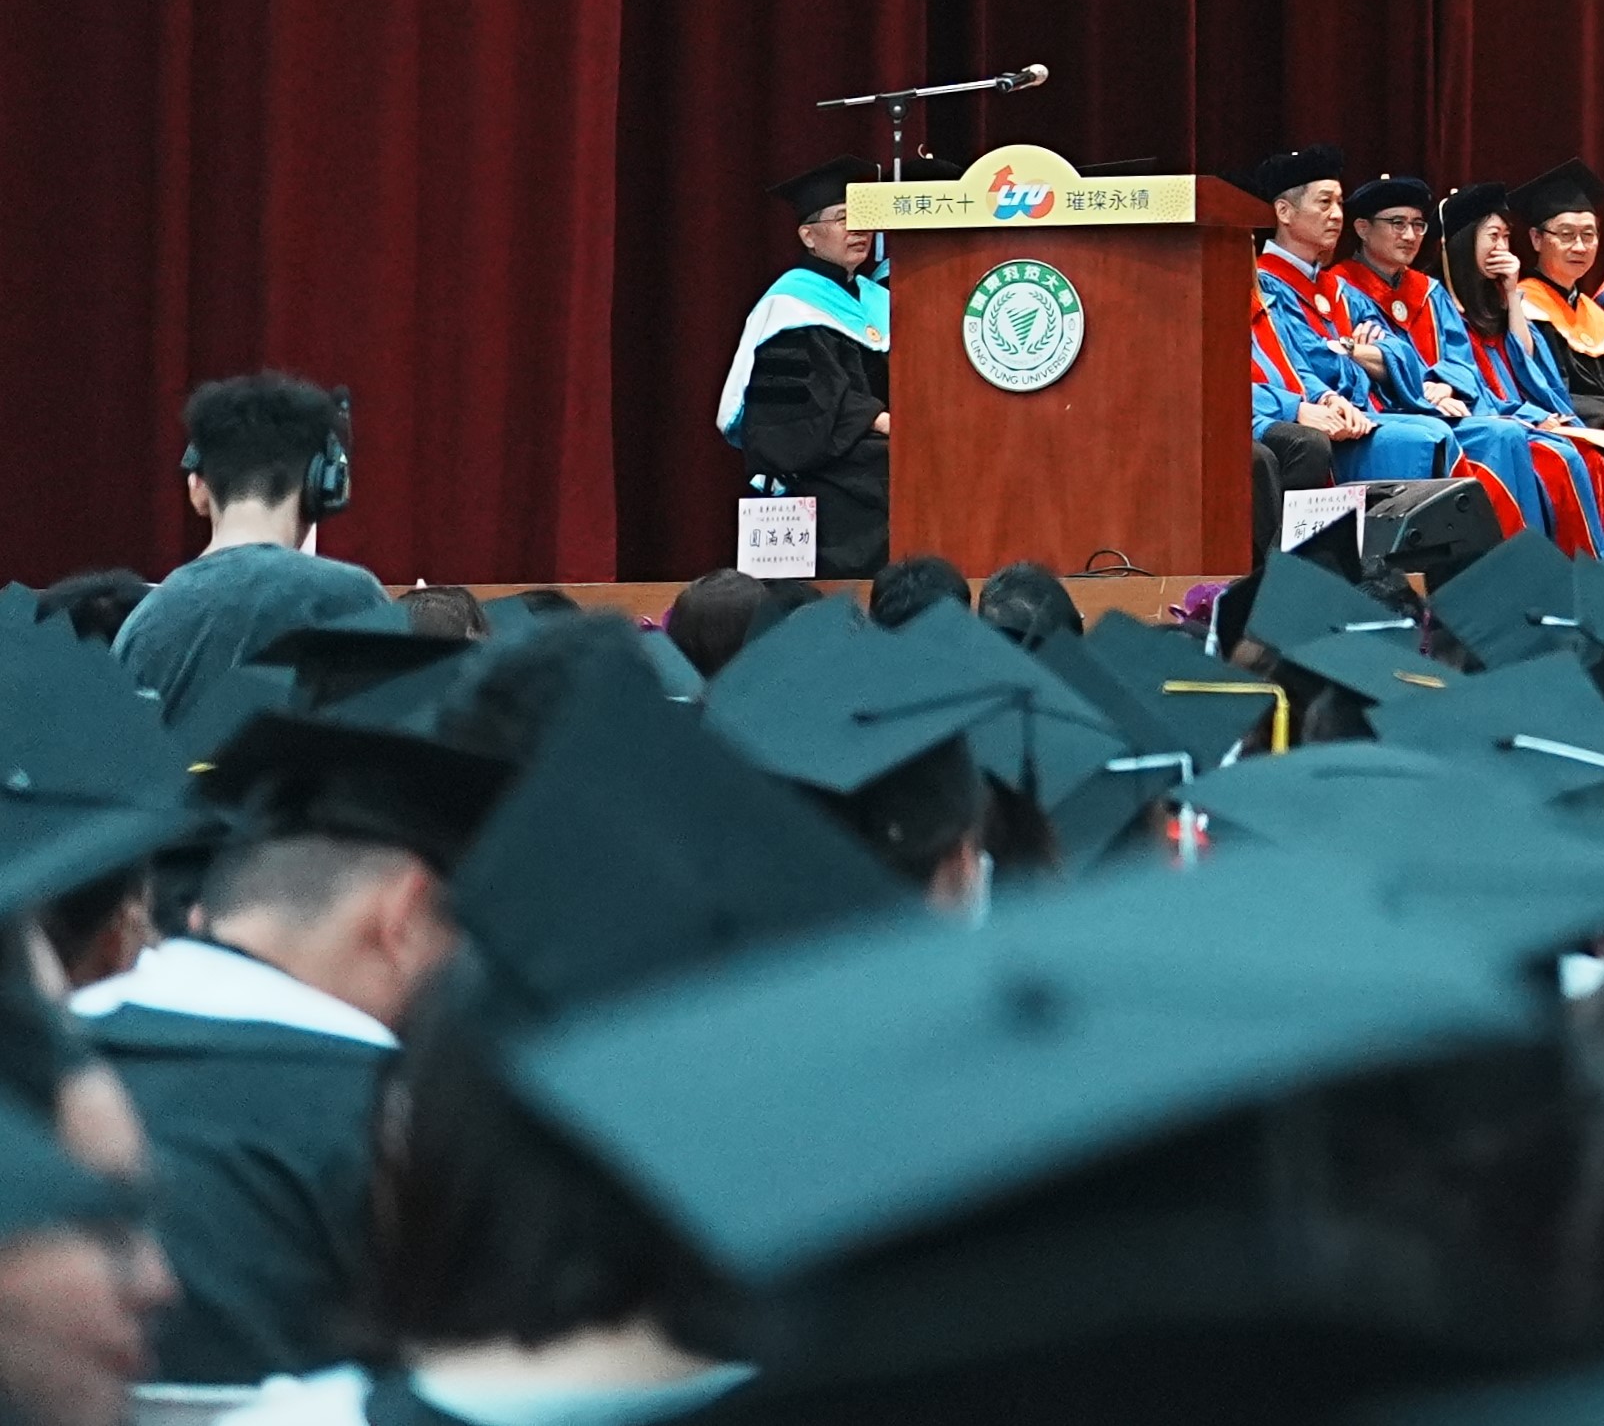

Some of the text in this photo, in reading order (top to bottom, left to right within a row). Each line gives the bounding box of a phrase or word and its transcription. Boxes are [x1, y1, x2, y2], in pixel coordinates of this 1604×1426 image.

[893, 194, 974, 214] 嶺東六十
[997, 183, 1052, 206] LTU
[1066, 188, 1149, 211] 璀璨永續
[970, 337, 1074, 385] LING TUNG UNIVERSITY
[750, 527, 810, 548] 圓滿成功
